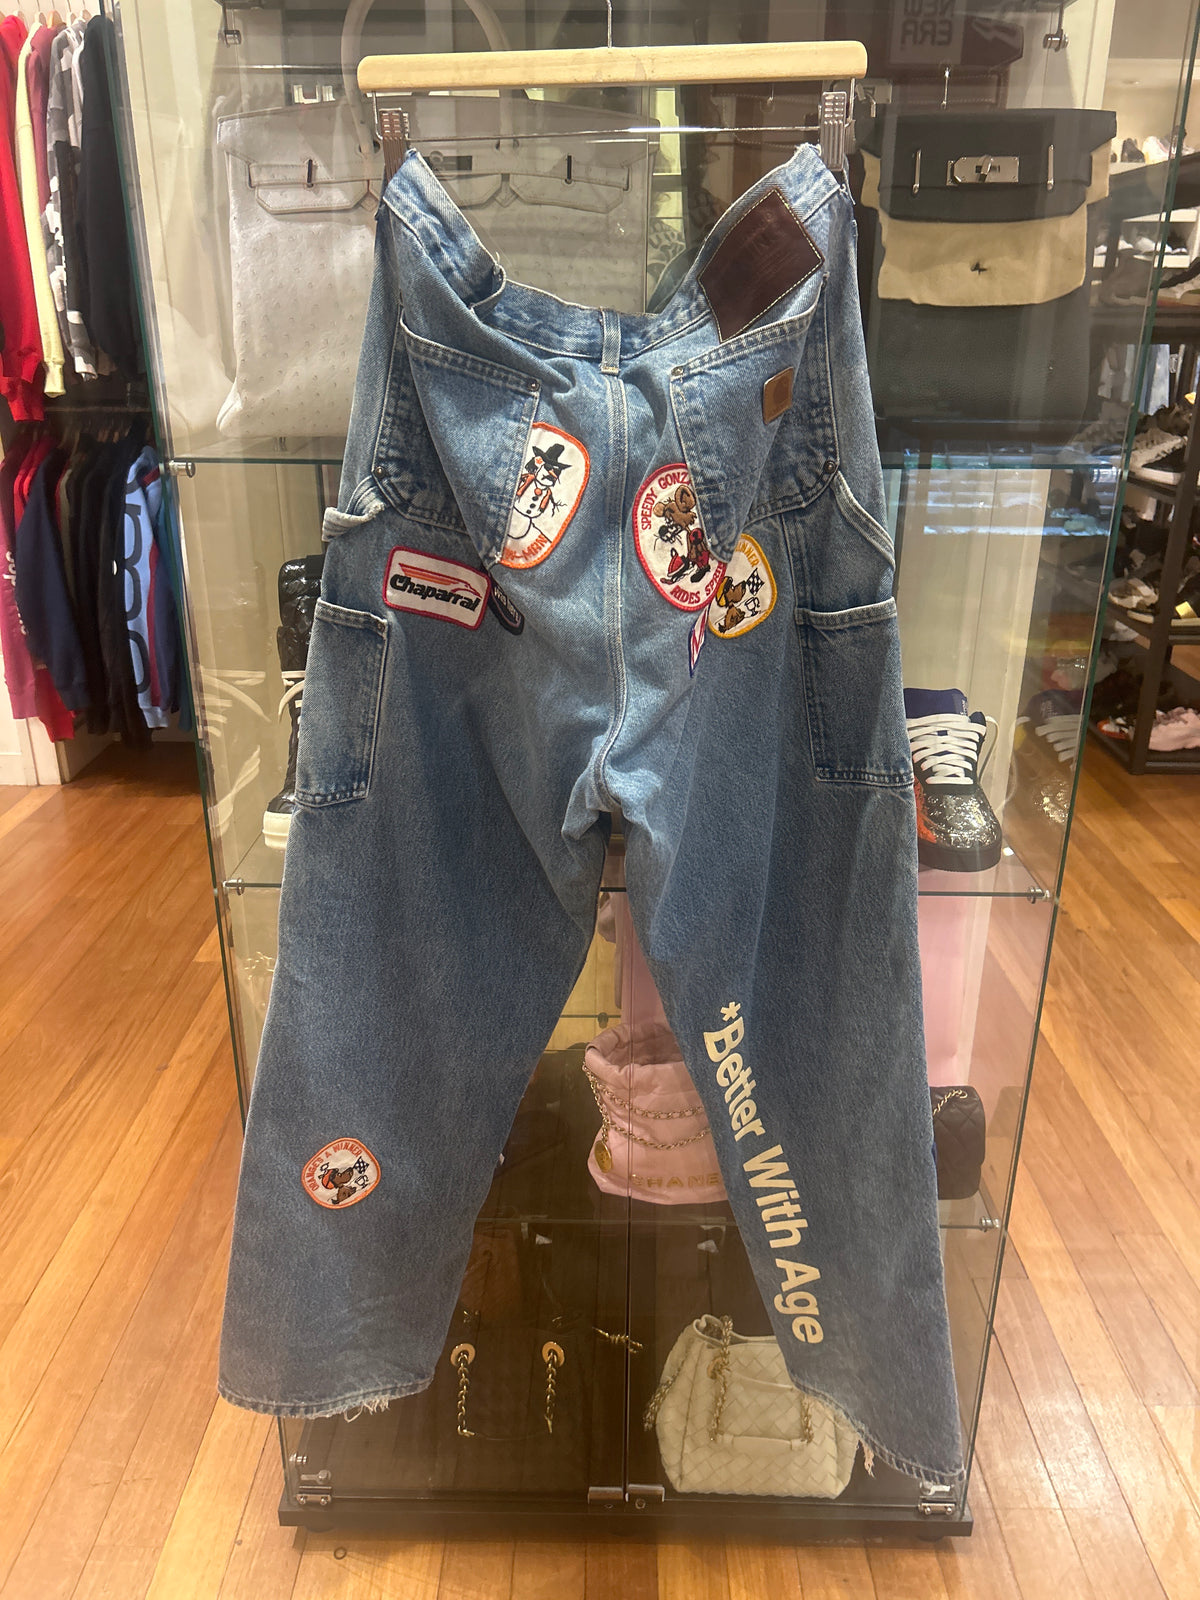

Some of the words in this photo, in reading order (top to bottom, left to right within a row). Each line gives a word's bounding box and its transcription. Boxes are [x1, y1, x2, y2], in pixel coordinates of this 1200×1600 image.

[641, 490, 659, 530] SPEEDY
[658, 471, 693, 490] GONZ
[735, 540, 760, 567] INNER
[389, 573, 482, 612] Chaparral
[670, 585, 701, 604] RIDES
[705, 562, 725, 597] SPRI
[333, 1142, 363, 1157] WINNER
[630, 1172, 721, 1188] CHANE
[742, 1143, 809, 1249] With
[773, 1258, 825, 1345] Age
